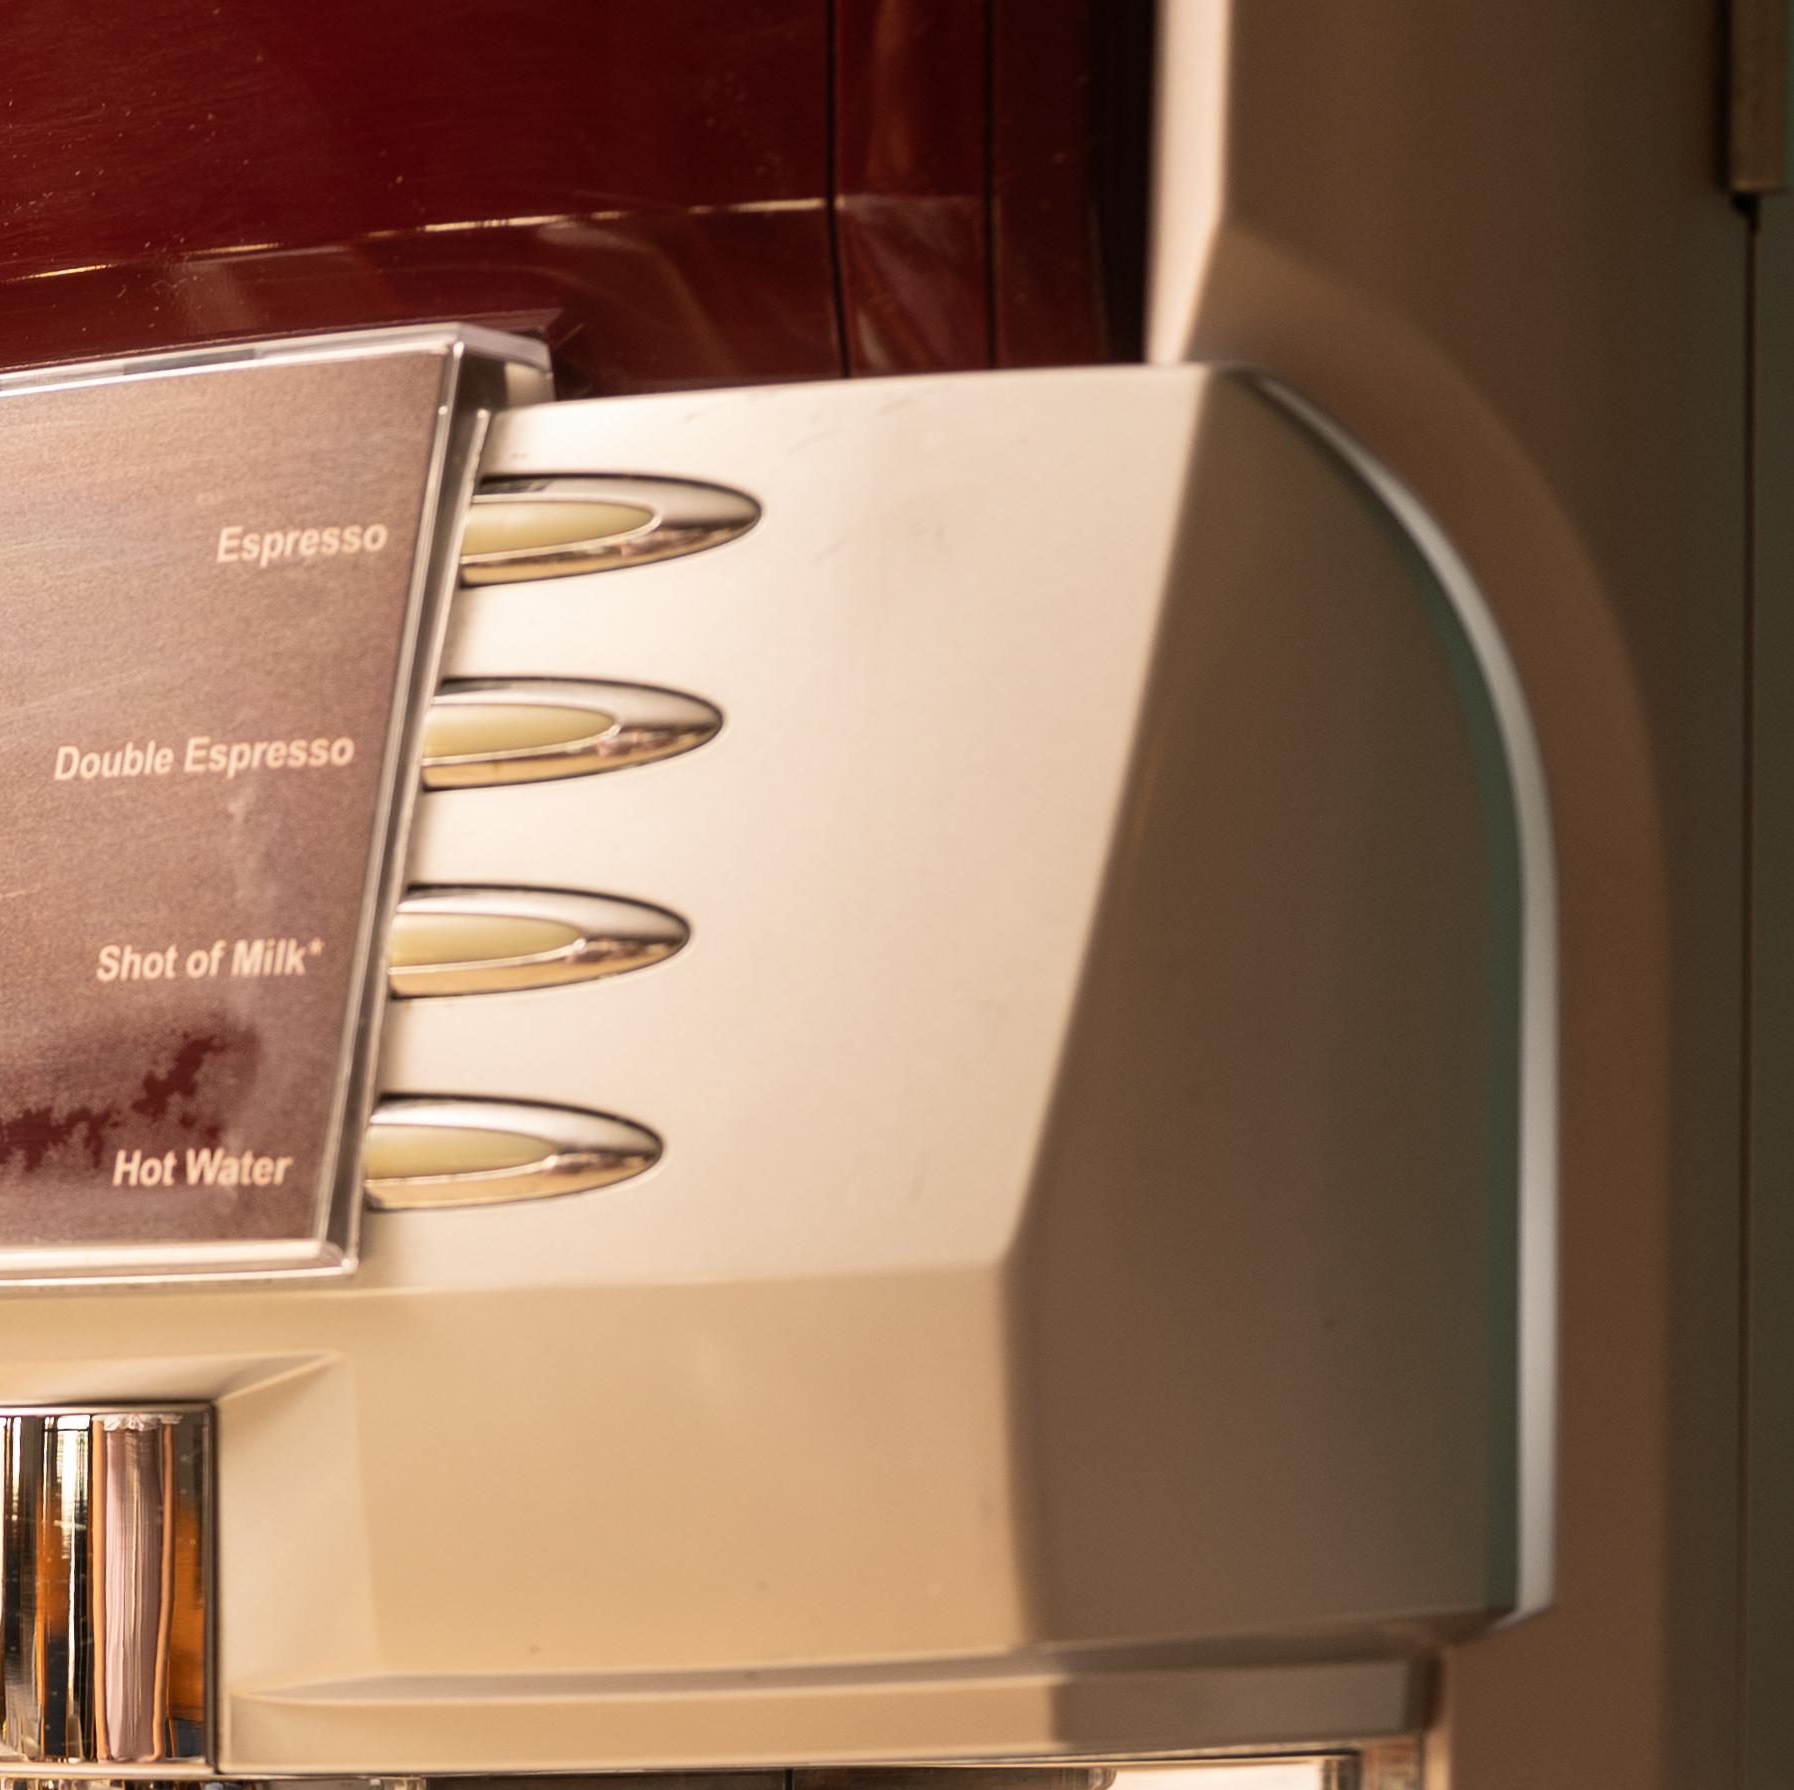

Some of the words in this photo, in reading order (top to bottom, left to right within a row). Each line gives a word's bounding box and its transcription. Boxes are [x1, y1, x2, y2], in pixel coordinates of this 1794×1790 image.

[217, 522, 388, 567] Espresso
[54, 741, 173, 781] Double
[184, 736, 355, 778] Espresso
[96, 944, 178, 982] Shot
[186, 941, 224, 979] of
[113, 1149, 177, 1186] Hot
[186, 1148, 292, 1187] Water
